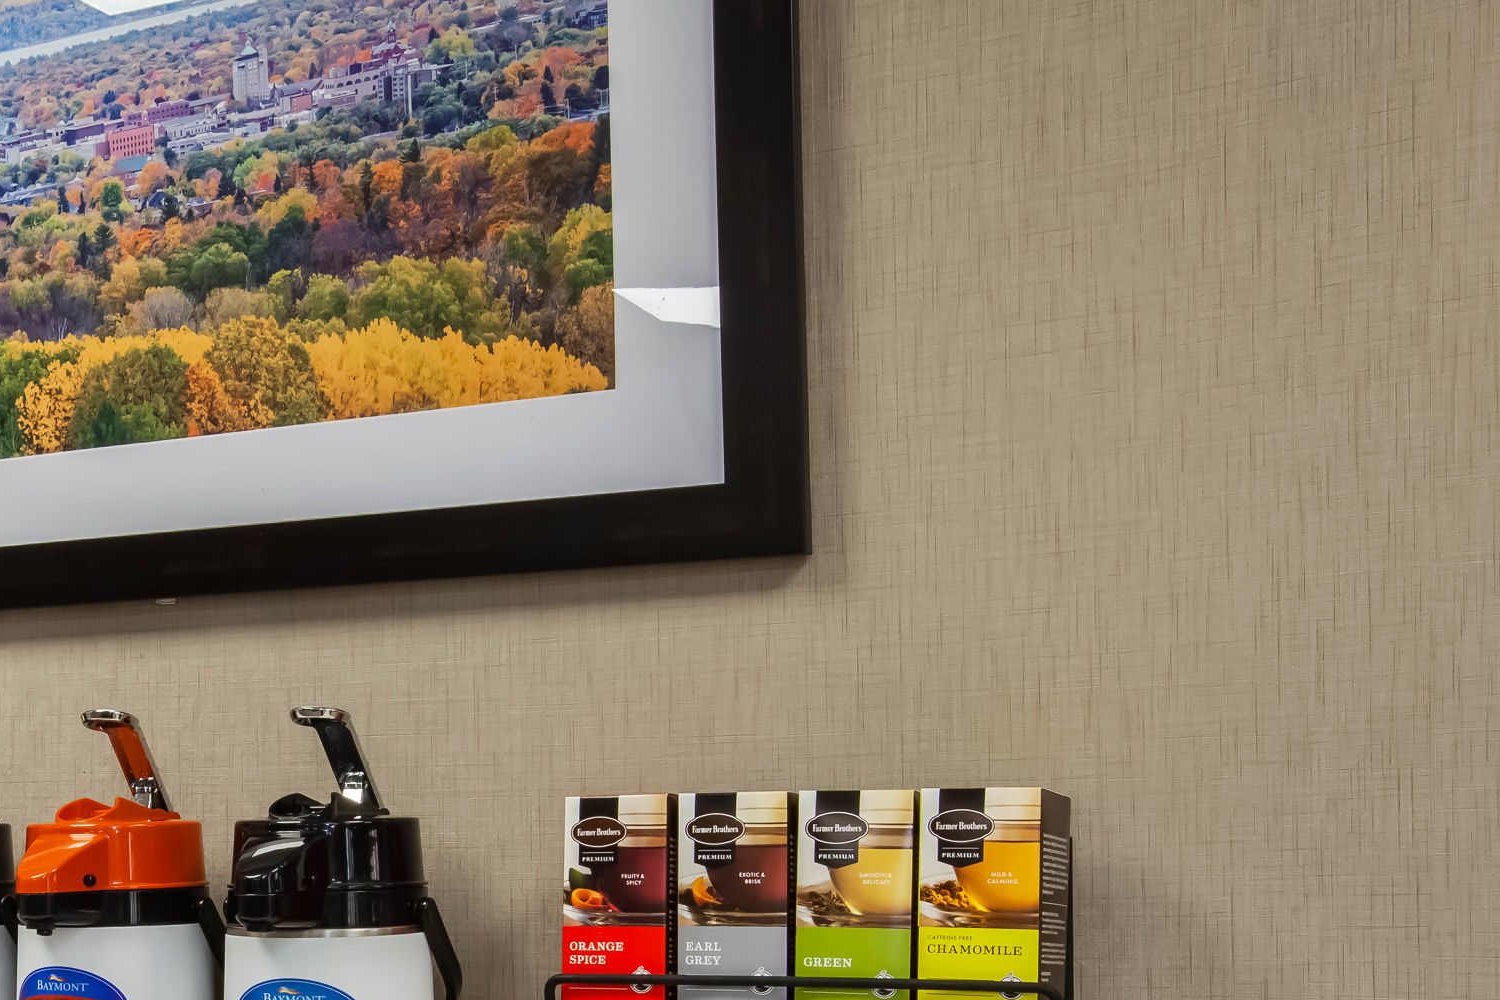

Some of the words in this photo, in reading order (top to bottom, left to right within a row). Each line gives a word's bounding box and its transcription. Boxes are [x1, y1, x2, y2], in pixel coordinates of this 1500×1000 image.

[692, 825, 712, 834] Farmer
[712, 824, 739, 834] Brothers
[812, 824, 834, 833] Farmer
[834, 823, 863, 833] Brothers
[935, 821, 958, 831] Farmer
[958, 821, 988, 831] Brothers
[577, 827, 596, 837] Farmer
[596, 827, 621, 837] Brothers
[569, 941, 624, 952] ORANGE
[685, 941, 722, 952] EARL
[927, 943, 1023, 957] CHAMOMILE
[569, 954, 606, 965] SPICE
[685, 955, 722, 966] GREY
[804, 956, 853, 968] GREEN
[37, 979, 87, 992] BAYMONT
